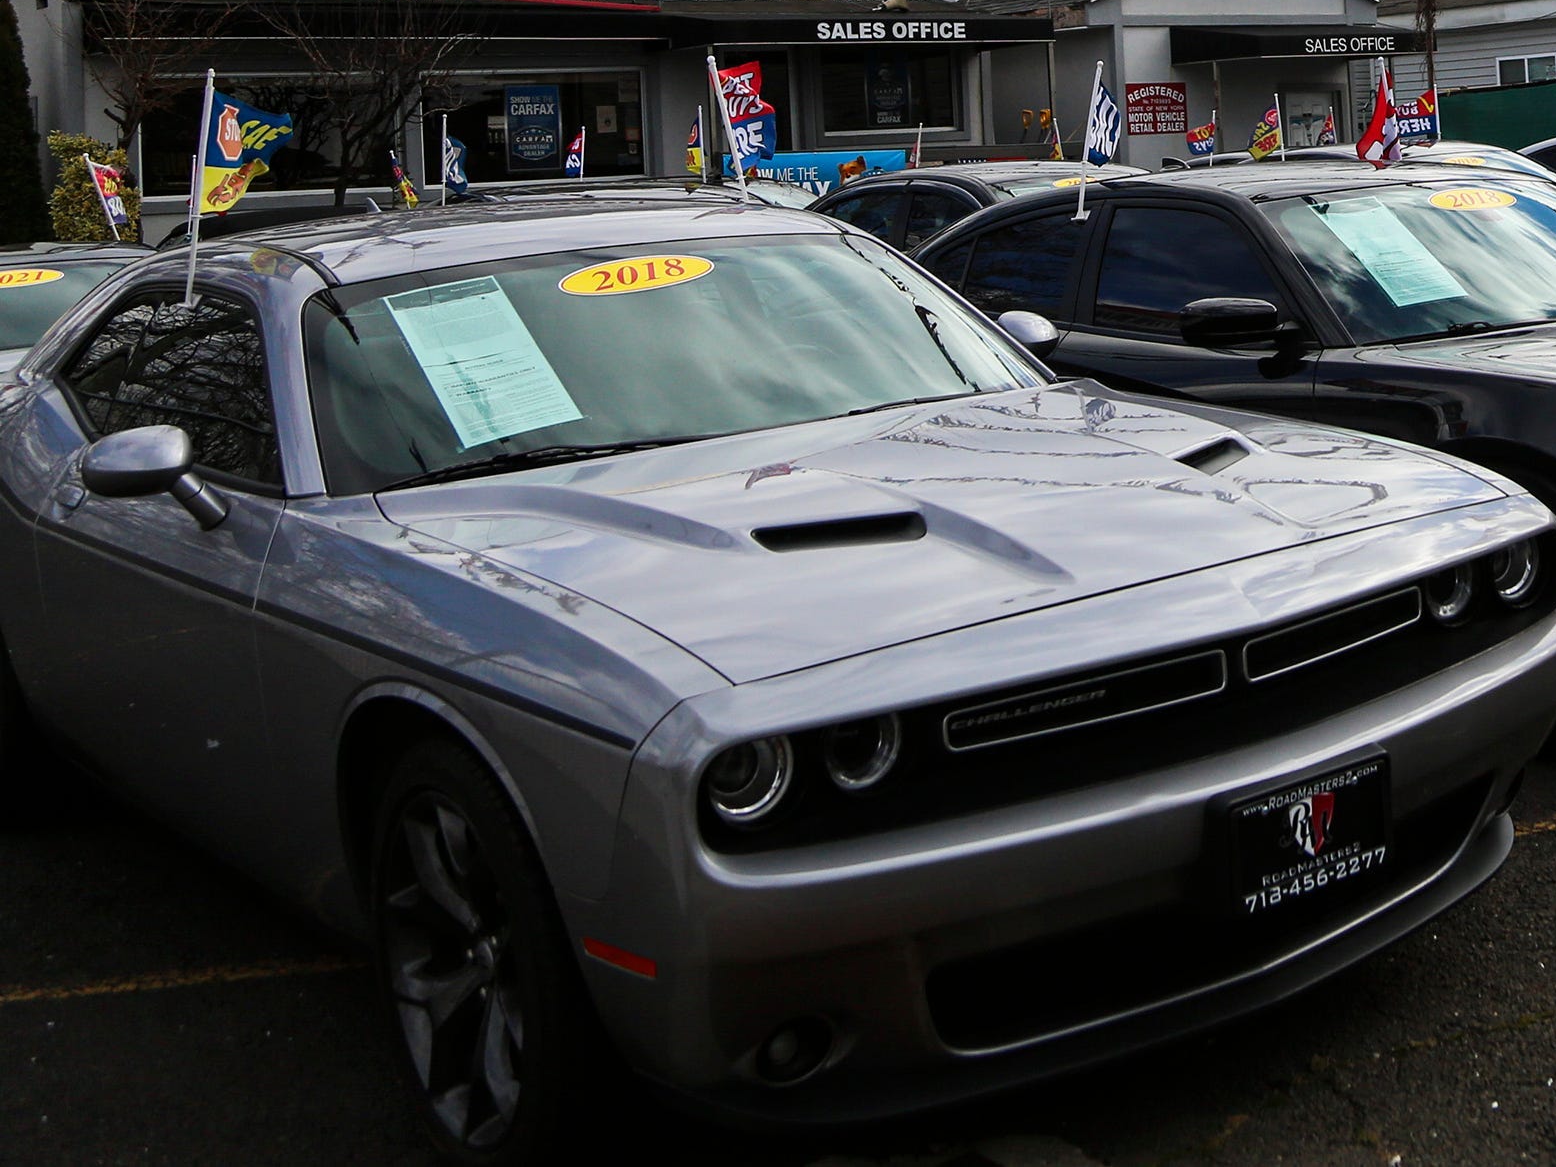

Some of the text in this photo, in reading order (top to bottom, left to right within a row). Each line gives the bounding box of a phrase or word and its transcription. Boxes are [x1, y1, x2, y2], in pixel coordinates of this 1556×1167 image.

[817, 22, 966, 39] SALES OFFICE
[1305, 37, 1395, 53] SALES OFFICE
[1127, 86, 1184, 103] REGISTERED
[510, 104, 555, 115] CARFAX
[724, 94, 764, 118] UYS
[1128, 112, 1185, 123] MOTOR VEHICLE
[1131, 122, 1185, 133] RETAIL DEALER
[756, 166, 819, 182] OW ME THE
[1446, 191, 1502, 208] 2018
[0, 271, 44, 283] 021
[592, 258, 686, 292] 2018
[1245, 846, 1386, 913] 718-456-2277
